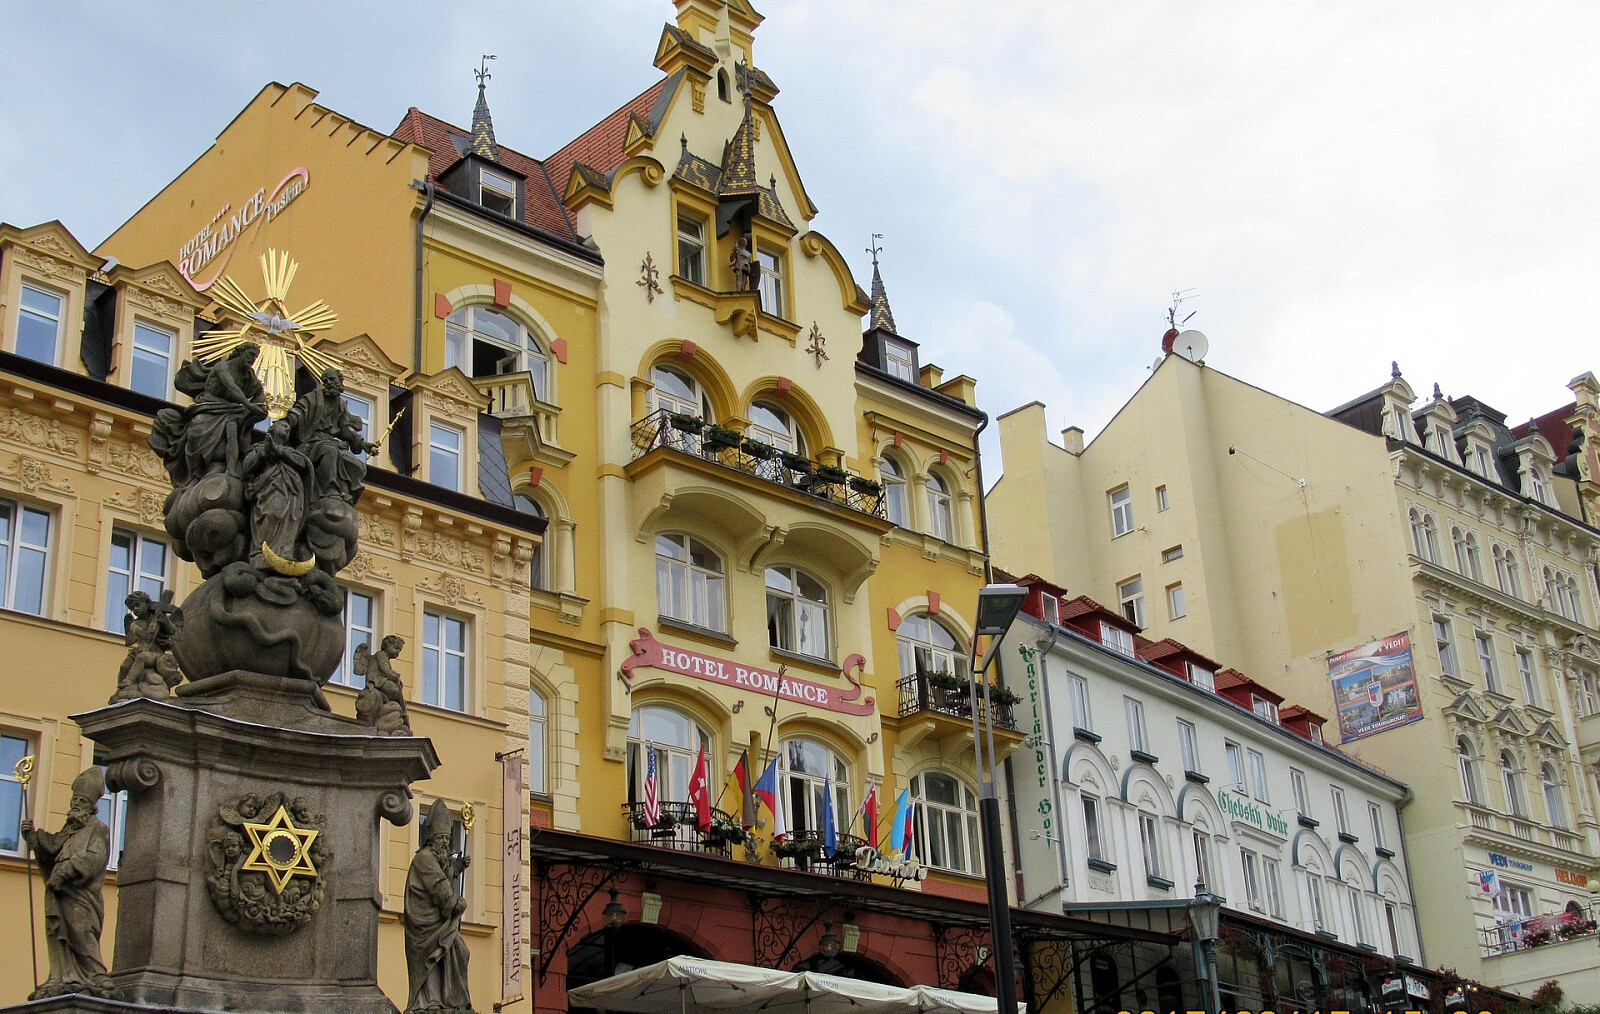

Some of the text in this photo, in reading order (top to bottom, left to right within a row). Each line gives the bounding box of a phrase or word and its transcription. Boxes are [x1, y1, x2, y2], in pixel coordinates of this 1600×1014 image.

[178, 181, 302, 280] ROMANCE Puškin
[179, 224, 213, 260] HOTEL
[661, 648, 829, 705] HOTEL ROMANCE
[1218, 789, 1263, 829] Chebský
[507, 829, 521, 984] Apartments 35
